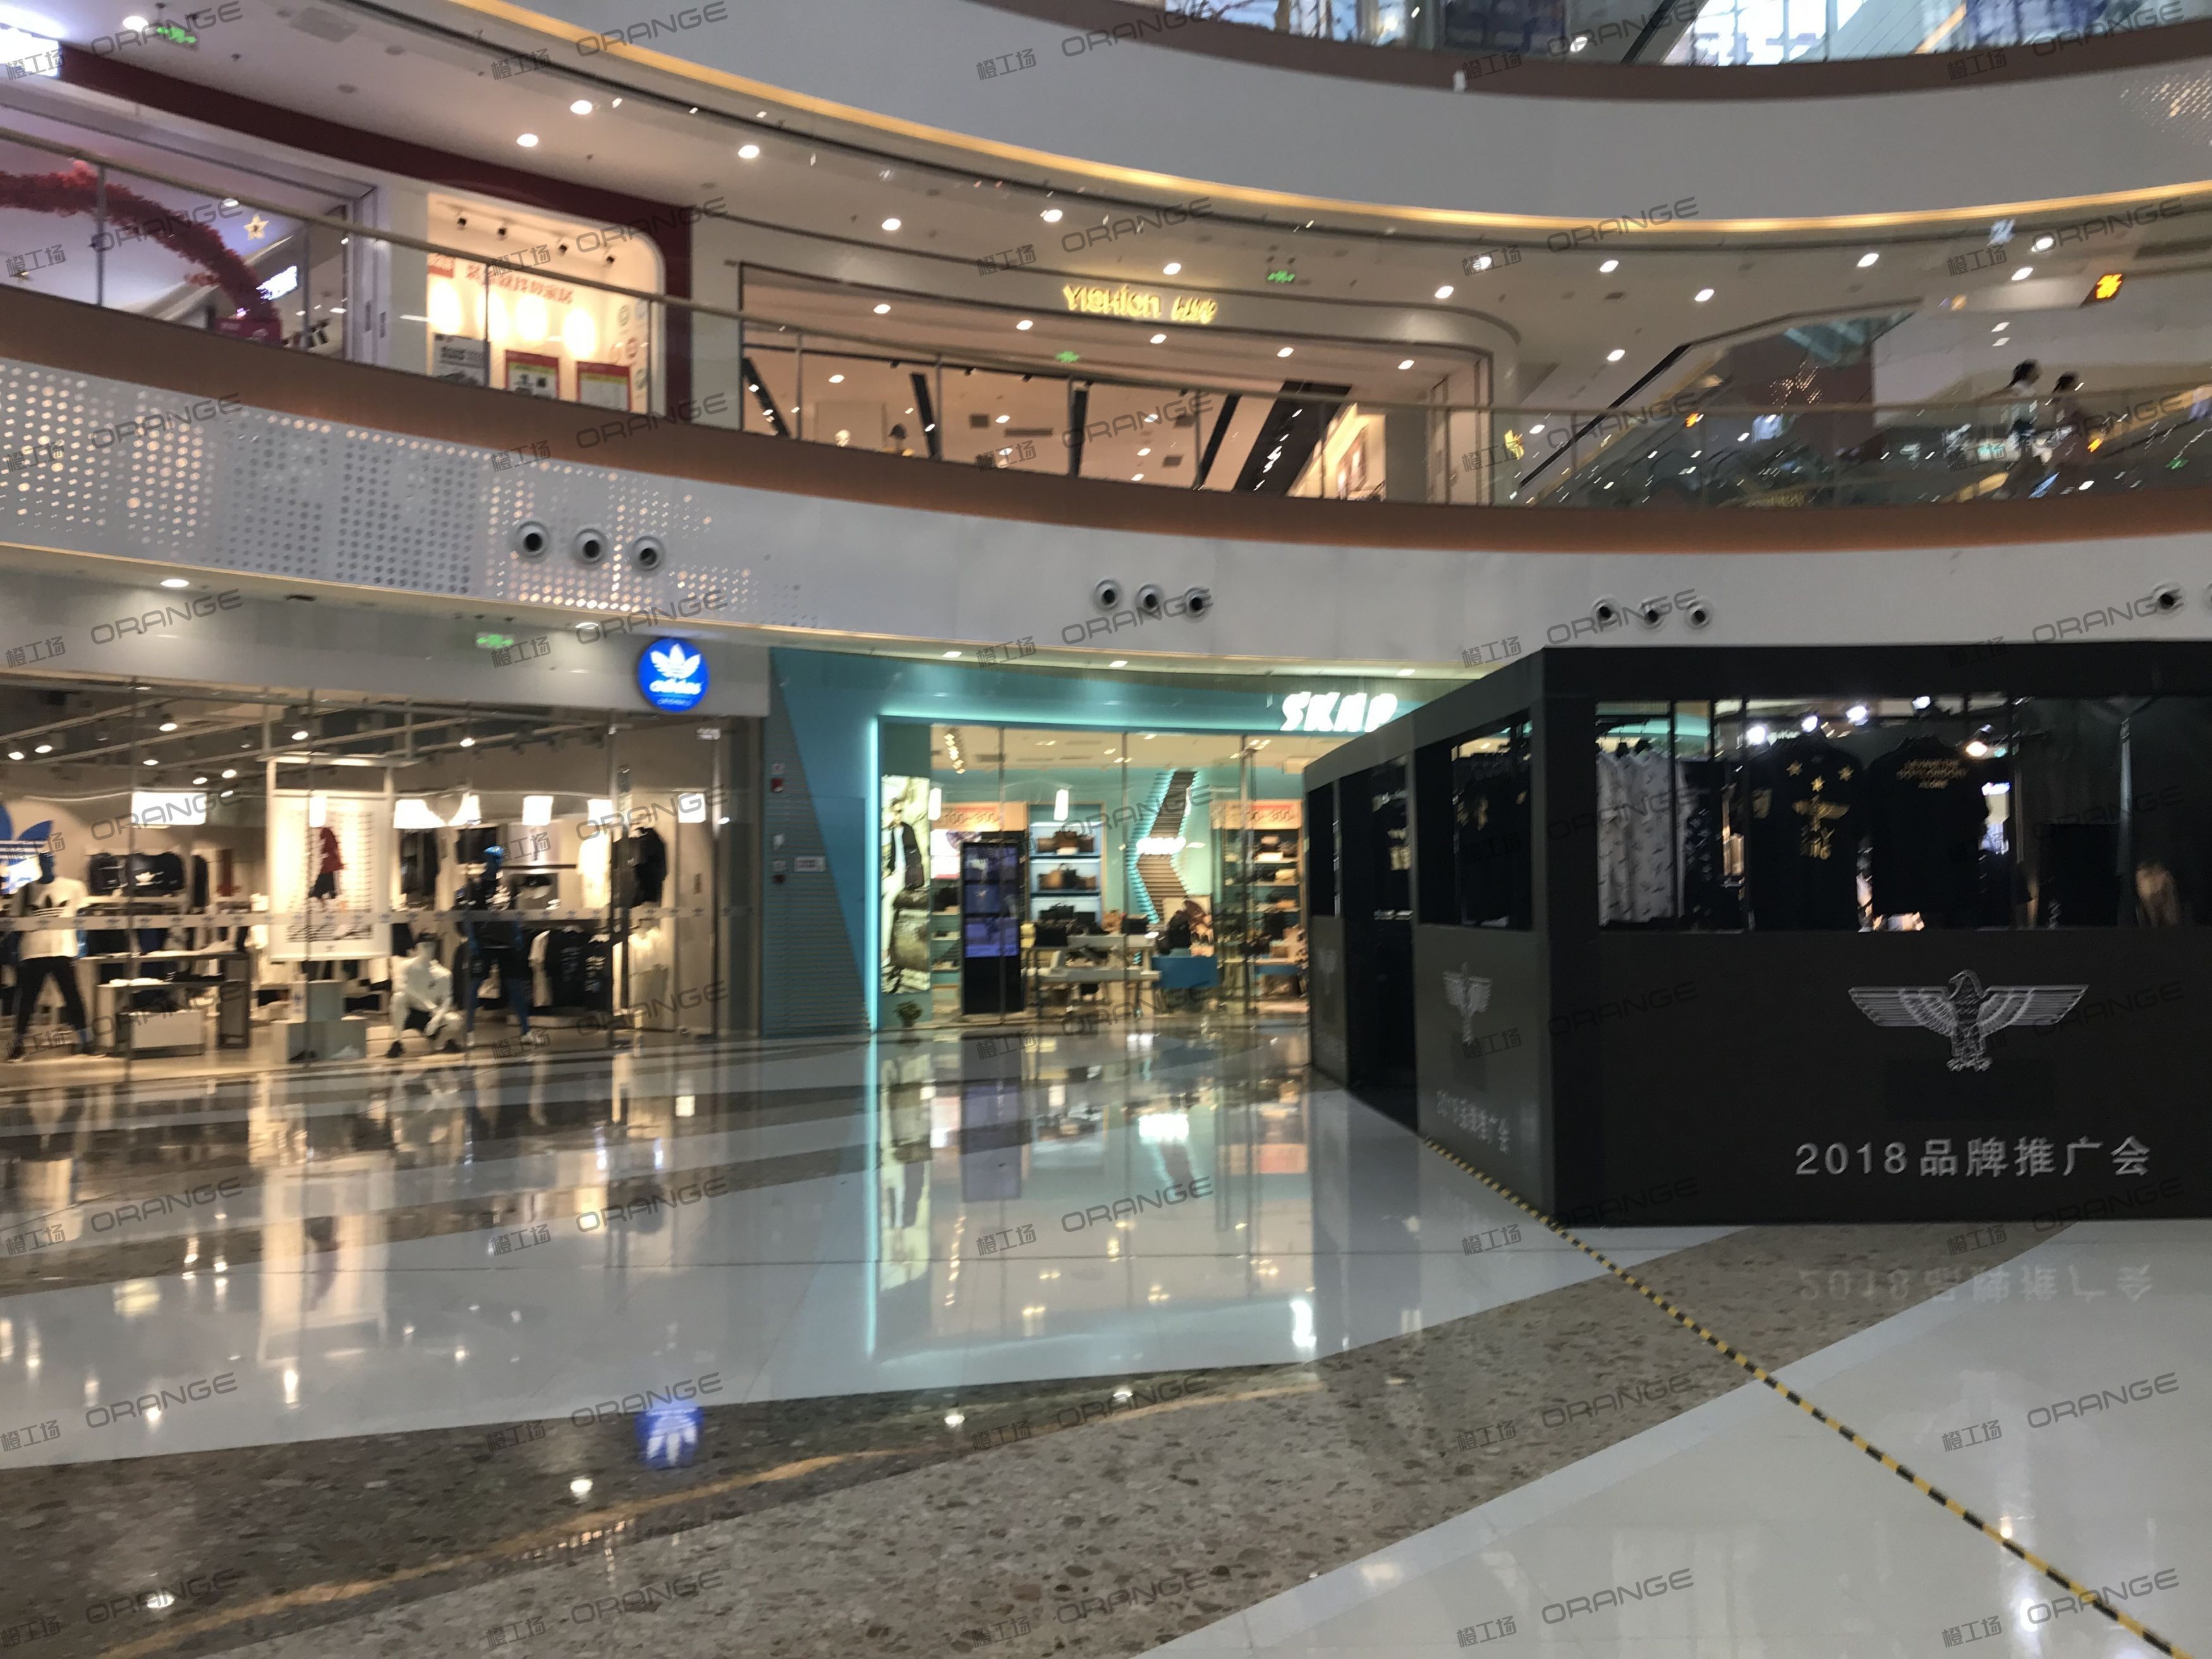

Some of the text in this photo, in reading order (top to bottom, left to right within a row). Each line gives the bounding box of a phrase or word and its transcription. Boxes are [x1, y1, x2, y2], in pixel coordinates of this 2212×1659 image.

[1796, 1136, 2150, 1177] 2018品牌推广会
